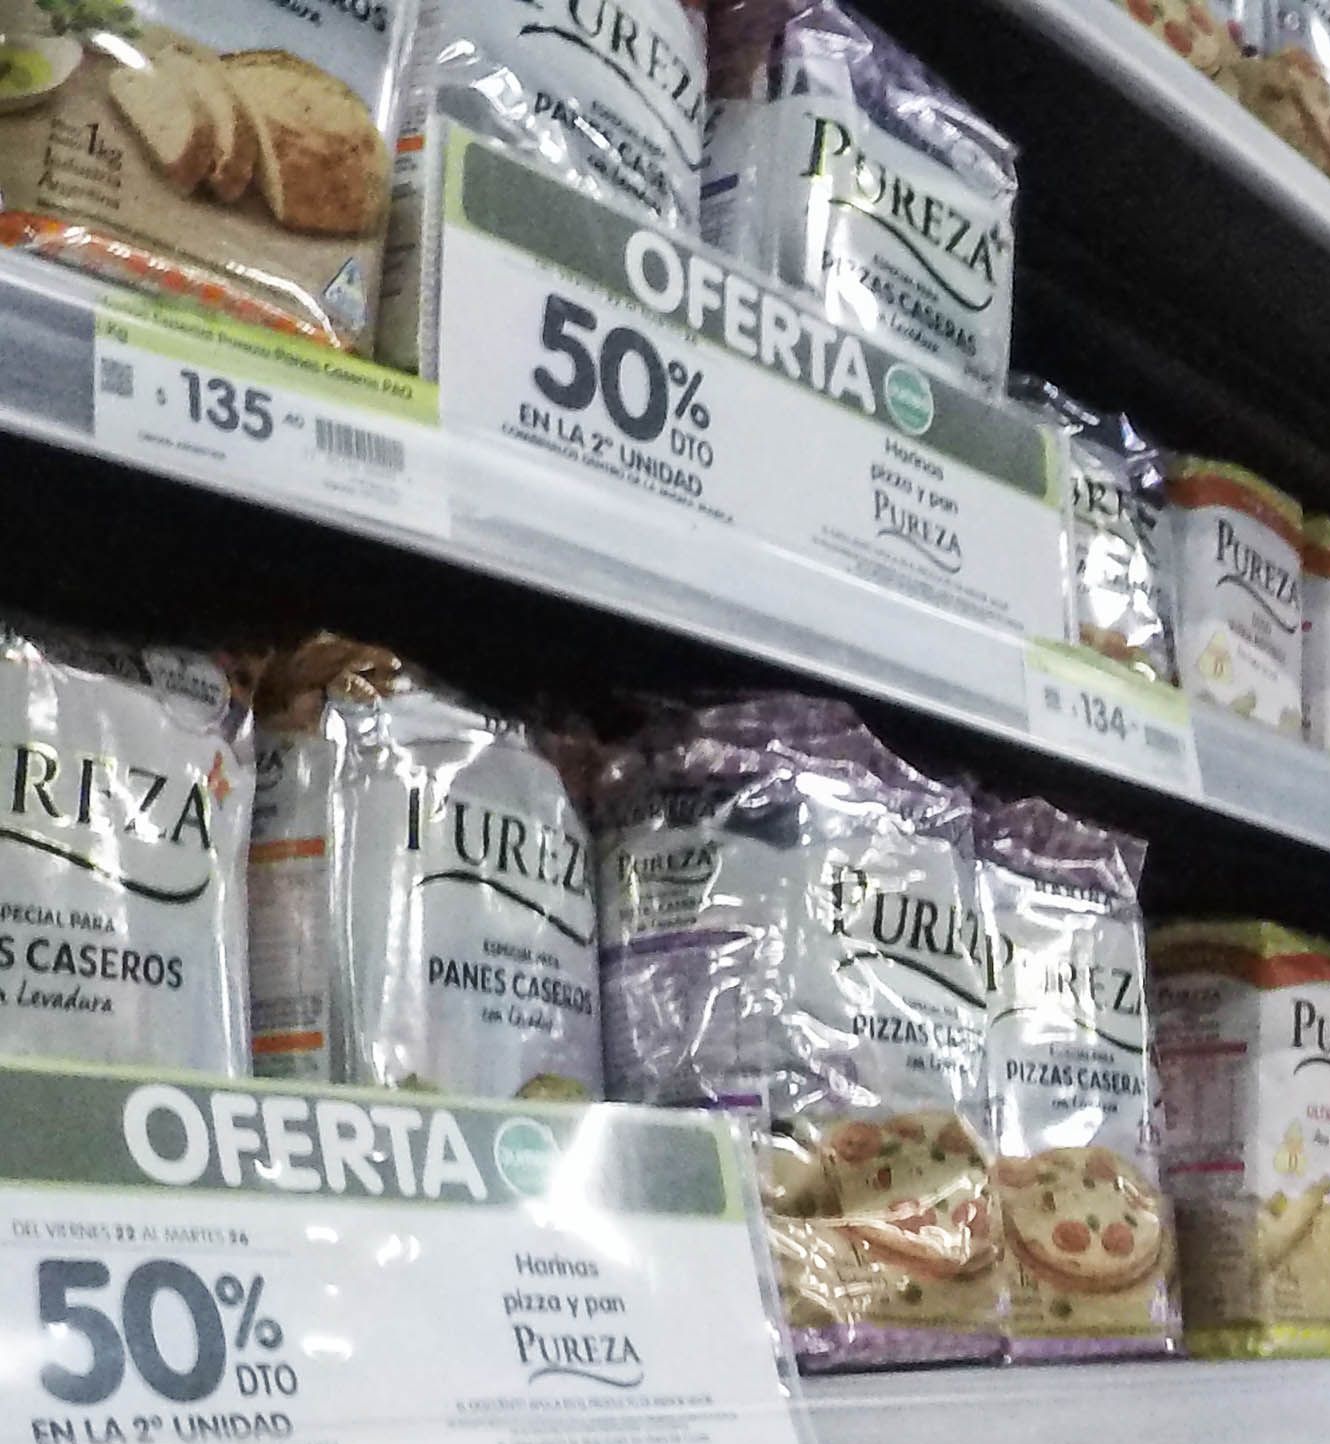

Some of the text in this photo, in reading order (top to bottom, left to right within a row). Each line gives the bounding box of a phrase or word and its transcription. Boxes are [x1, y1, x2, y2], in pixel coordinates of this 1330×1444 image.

[800, 112, 997, 290] PUREZA
[625, 230, 877, 416] OFERTA
[180, 367, 275, 442] 135
[519, 403, 550, 433] EN
[558, 417, 585, 447] LA
[620, 444, 704, 498] UNIDAD
[671, 427, 714, 469] DTO
[874, 488, 963, 560] PUREZA
[1081, 691, 1127, 741] 134
[25, 938, 184, 990] CASEROS
[427, 955, 593, 1016] PANES CASEROS
[17, 980, 114, 1014] Levadura
[853, 1012, 930, 1046] PIZZAS
[1005, 1059, 1073, 1088] PIZZAS
[122, 1083, 489, 1201] OFERTA
[514, 1251, 600, 1279] Harinas
[503, 1290, 562, 1316] pizza
[584, 1297, 626, 1319] pan
[513, 1323, 641, 1366] PUREZA
[236, 1363, 299, 1397] DTO
[84, 1416, 126, 1444] LA
[172, 1412, 293, 1443] UNIDAD
